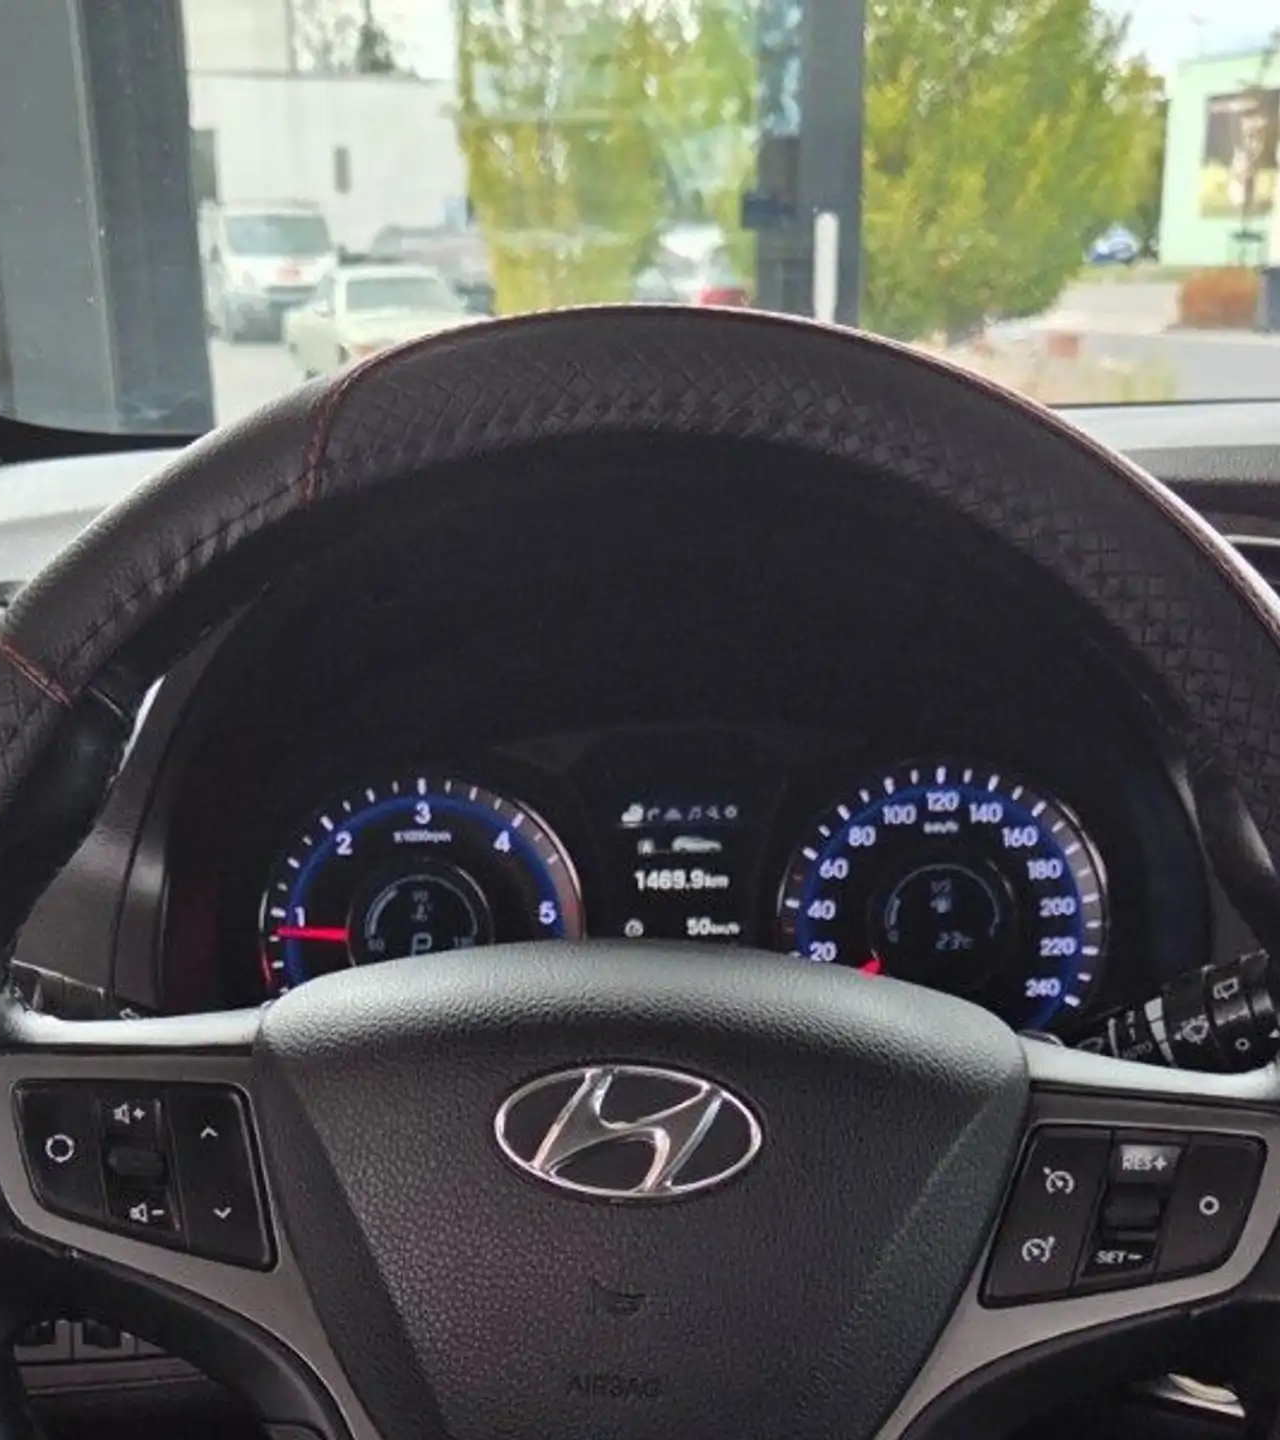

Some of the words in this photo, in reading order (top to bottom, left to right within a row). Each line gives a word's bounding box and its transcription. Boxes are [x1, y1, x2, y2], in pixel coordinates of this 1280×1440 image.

[414, 801, 431, 824] 3
[926, 792, 960, 812] 120
[883, 804, 917, 825] 100
[969, 803, 1003, 824] 140
[335, 831, 353, 855] 2
[492, 831, 510, 853] 4
[848, 826, 876, 847] 80
[1001, 826, 1038, 848] 160
[820, 857, 849, 880] 60
[1027, 858, 1063, 880] 180
[538, 901, 556, 925] 5
[807, 899, 836, 920] 40
[1039, 896, 1076, 916] 200
[294, 906, 306, 928] 1
[809, 941, 837, 962] 20
[1039, 936, 1077, 956] 220
[1025, 977, 1061, 998] 240
